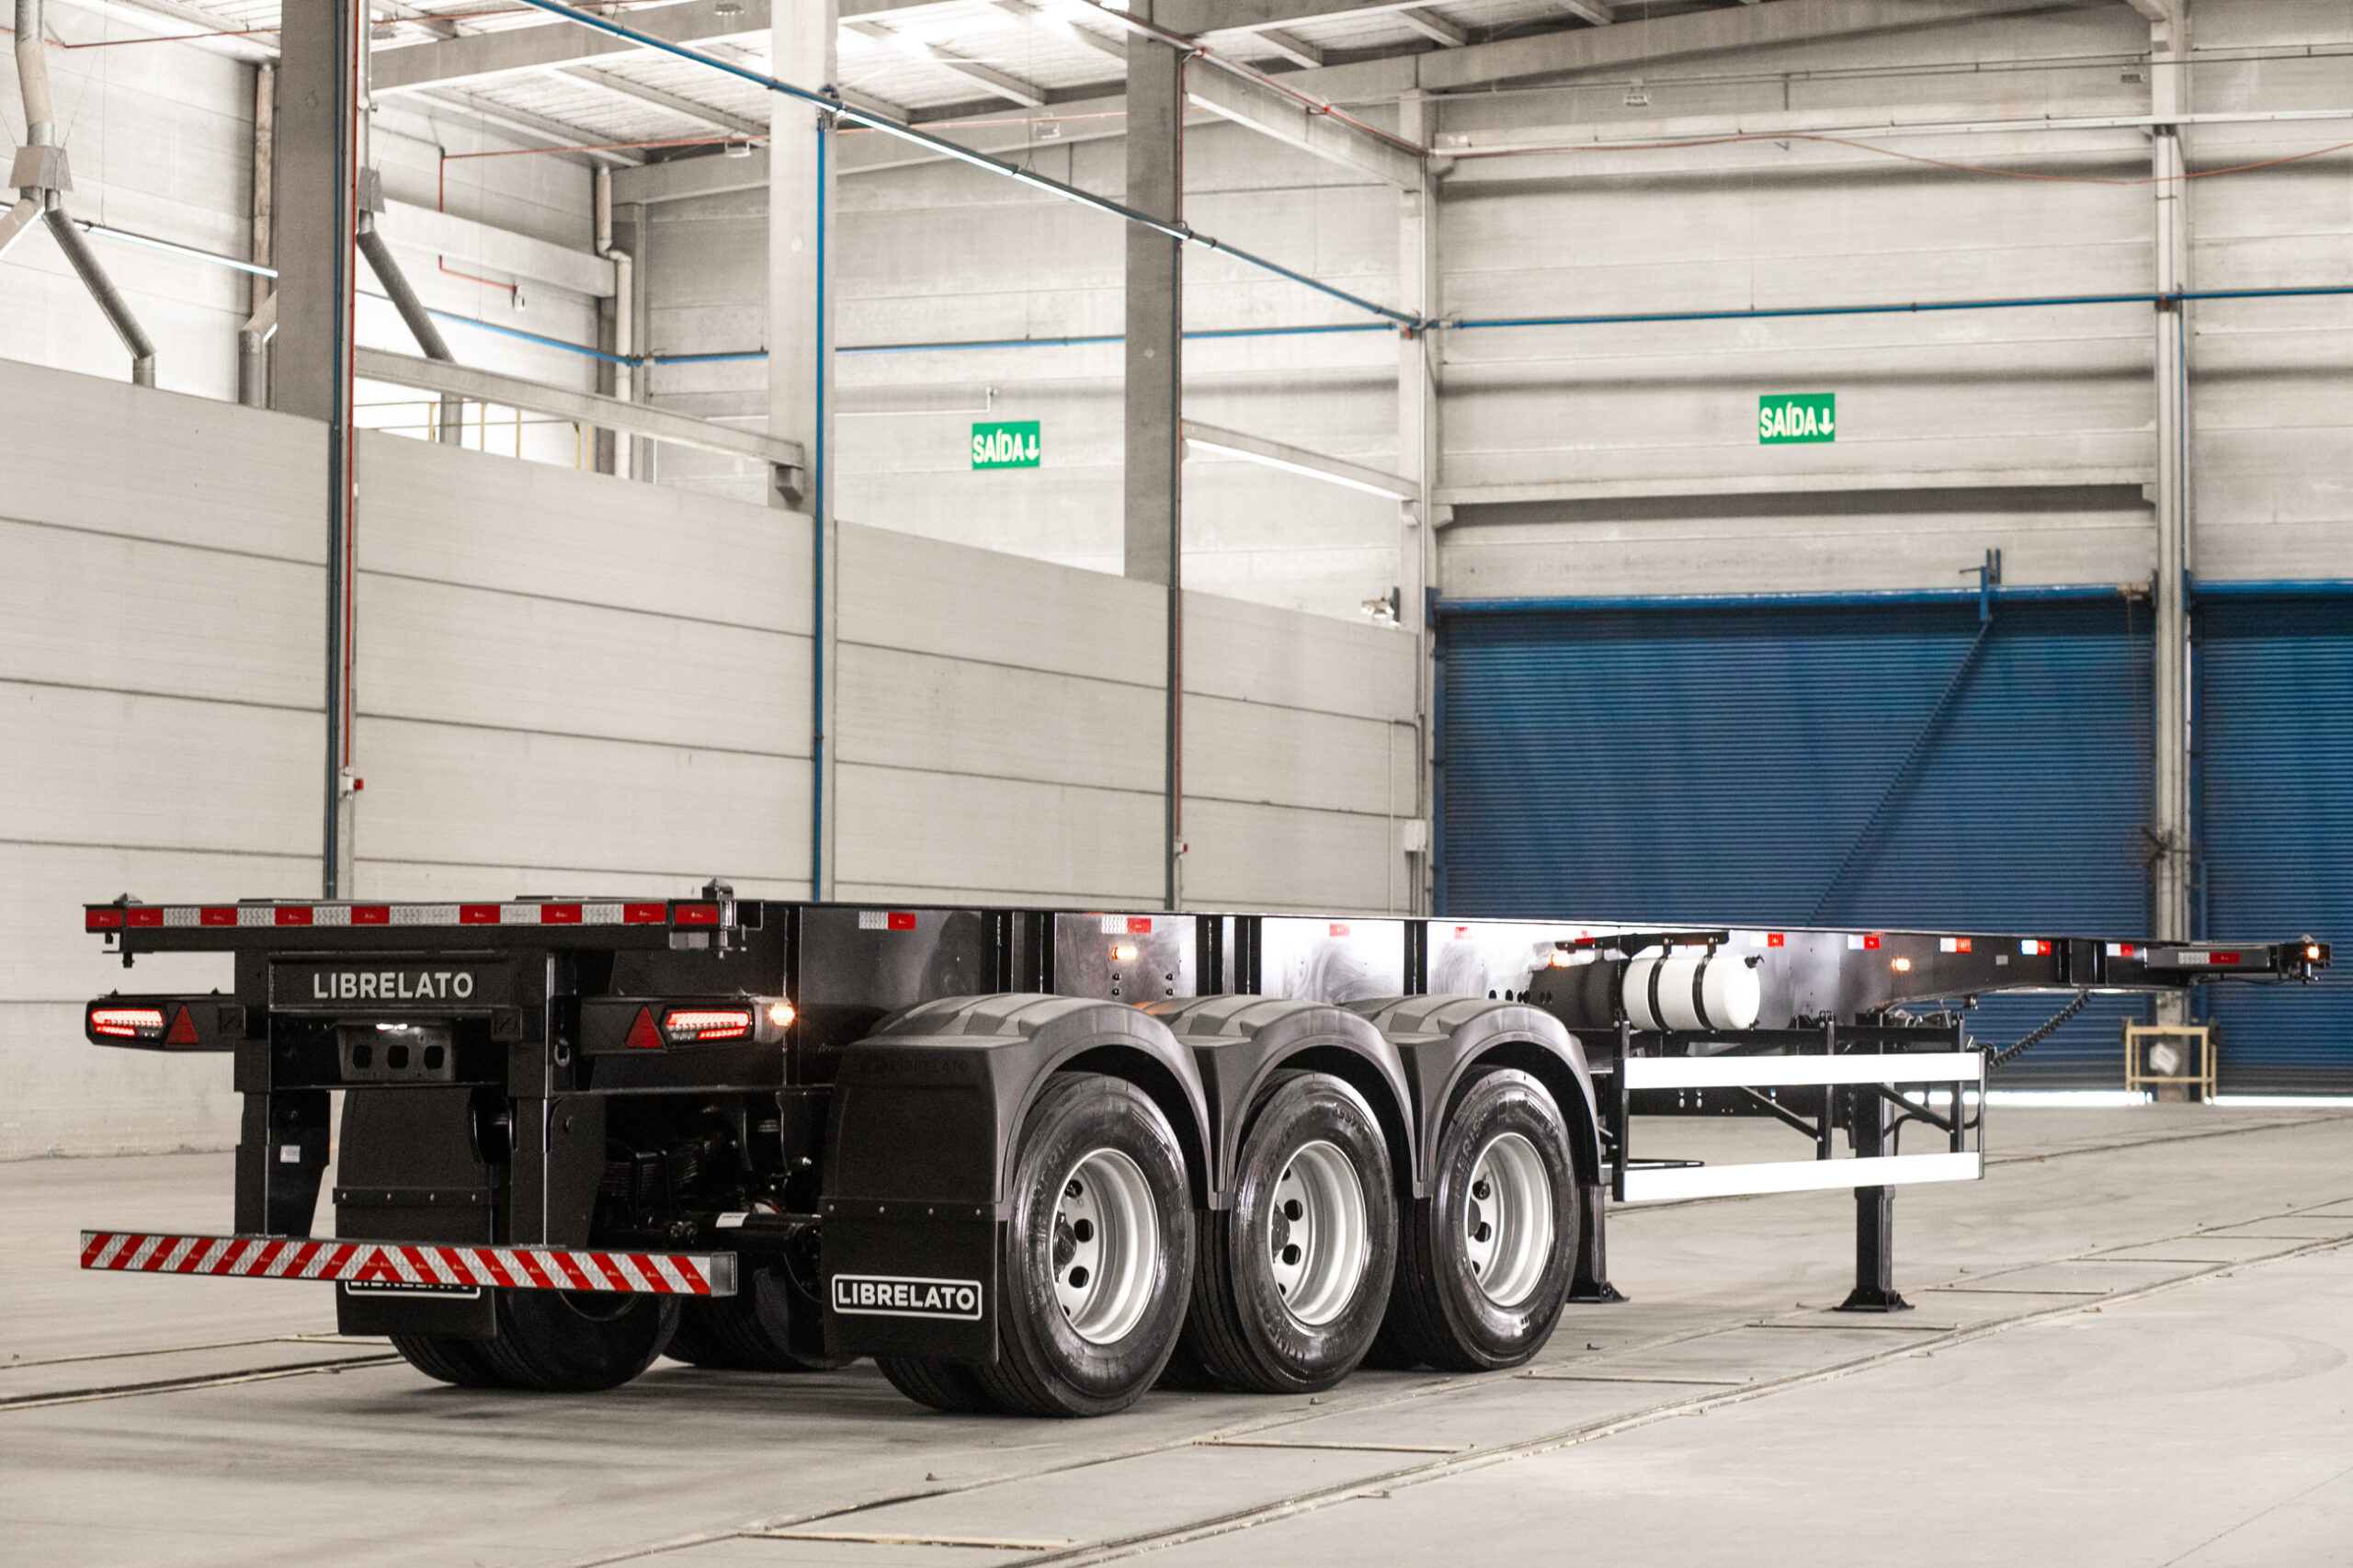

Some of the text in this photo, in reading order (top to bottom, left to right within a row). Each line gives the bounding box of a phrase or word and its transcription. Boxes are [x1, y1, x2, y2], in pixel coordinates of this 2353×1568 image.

[1760, 402, 1818, 438] SAÍDA
[973, 428, 1025, 463] SAÍDA
[313, 971, 473, 999] LIBRELATO
[838, 1282, 975, 1312] LIBRELATO
